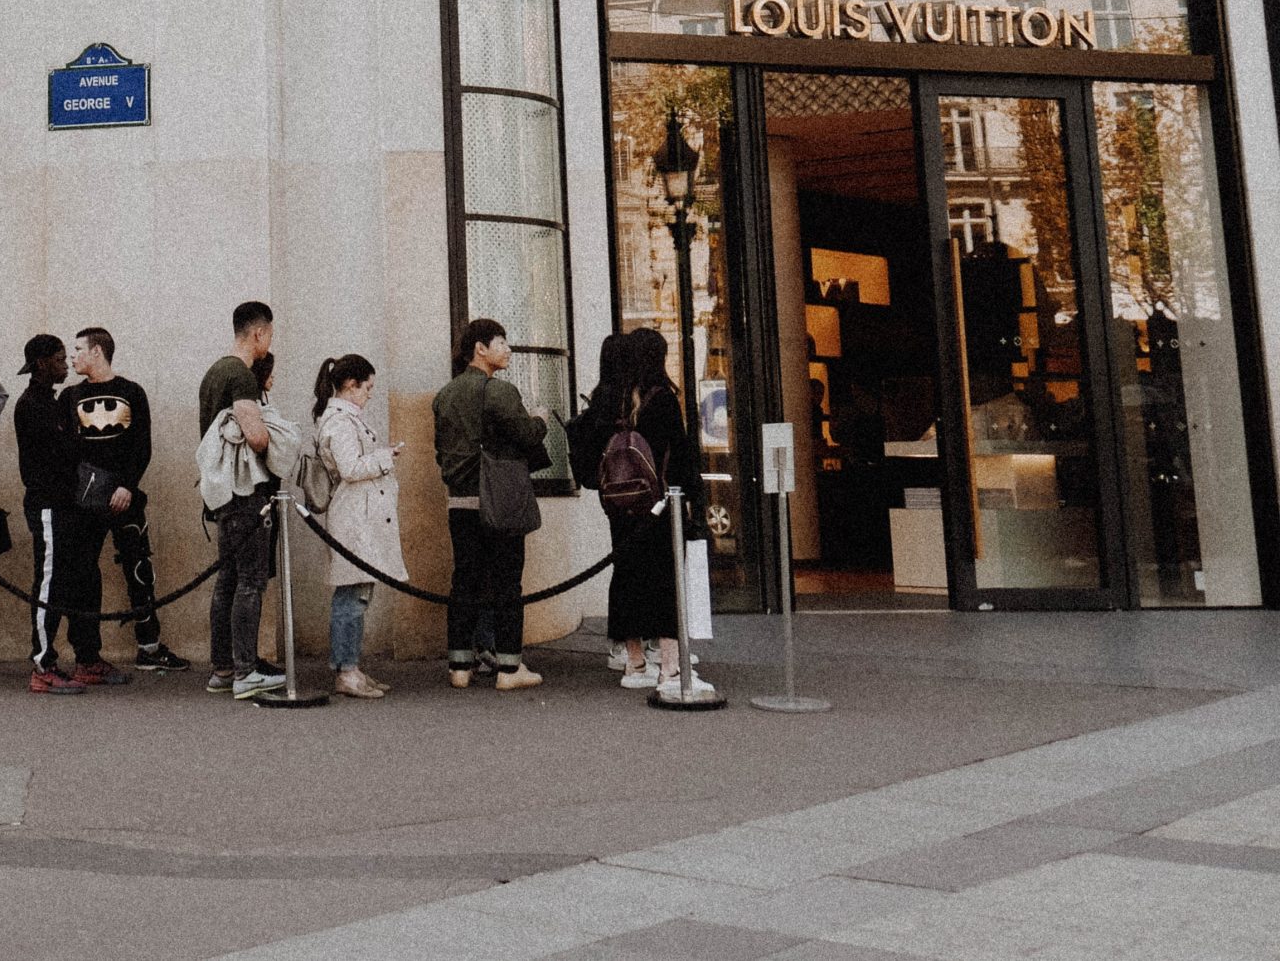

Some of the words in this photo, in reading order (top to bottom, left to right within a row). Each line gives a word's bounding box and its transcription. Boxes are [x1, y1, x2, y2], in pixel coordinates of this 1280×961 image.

[883, 0, 1096, 51] VUITTON
[79, 75, 119, 88] AVENUE
[63, 97, 111, 111] GEORGE
[125, 96, 134, 108] V
